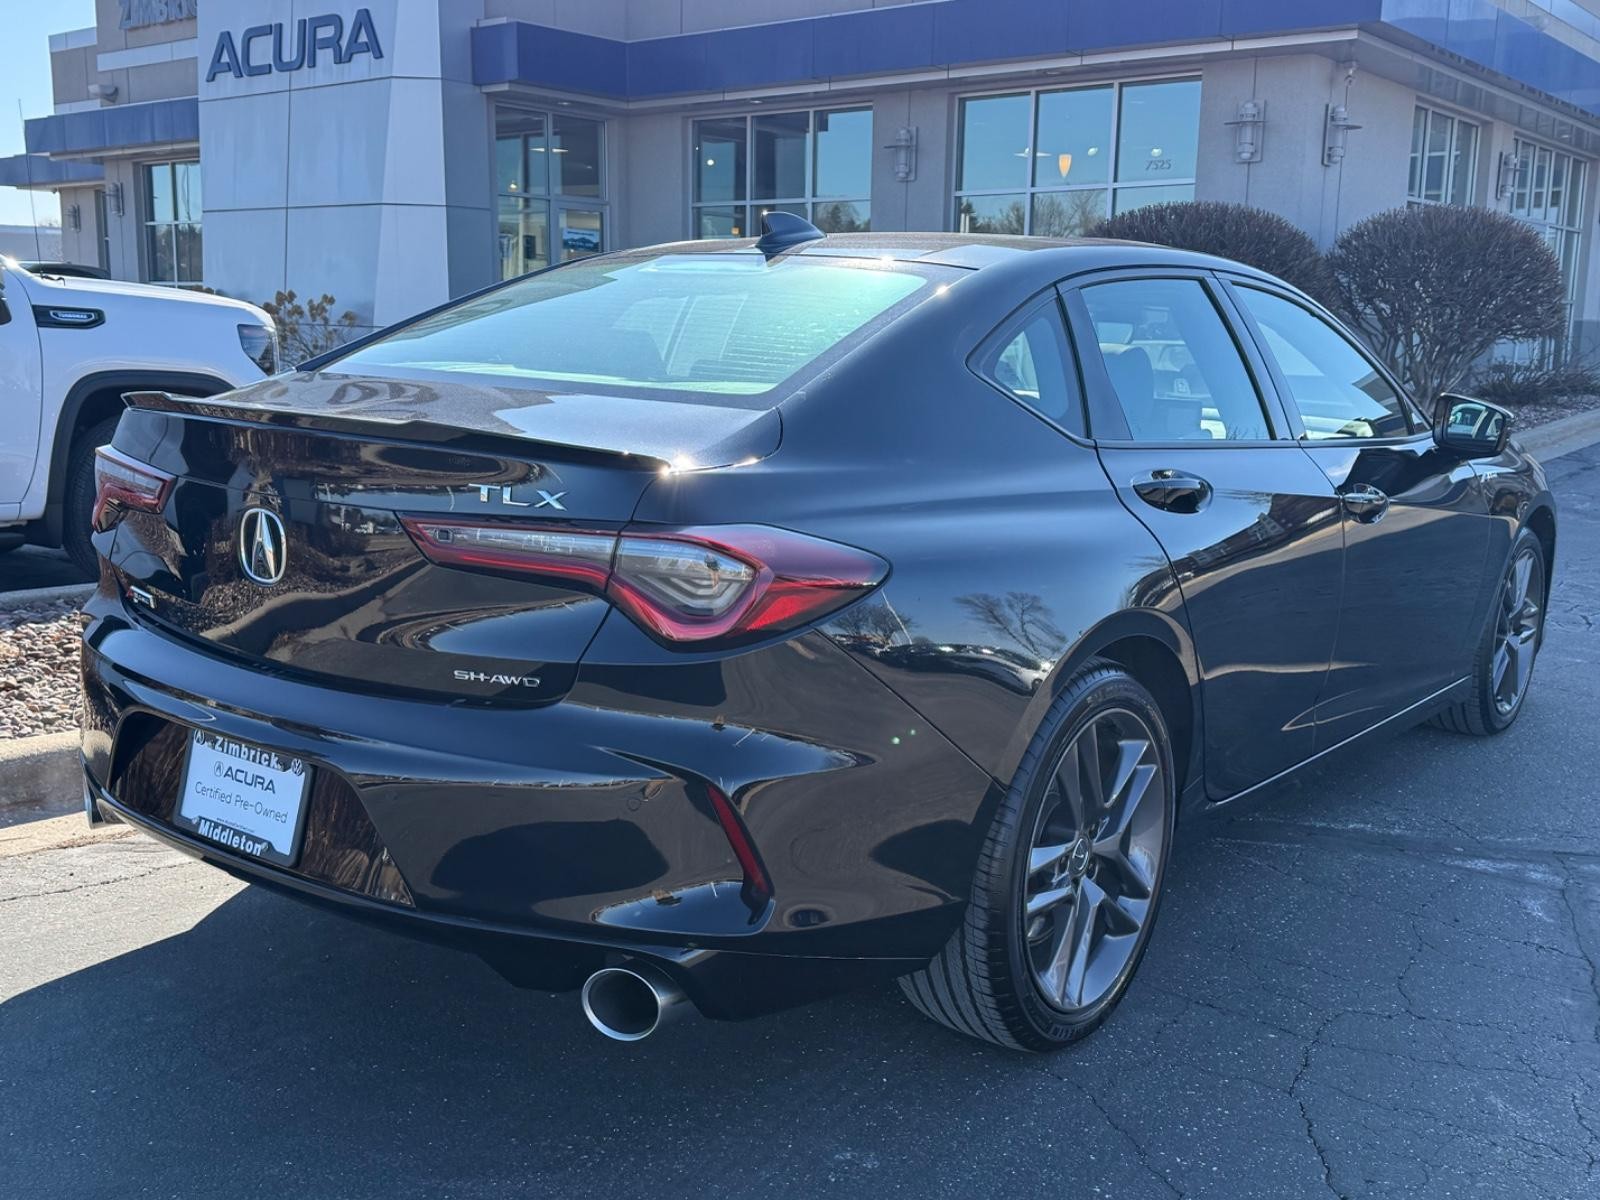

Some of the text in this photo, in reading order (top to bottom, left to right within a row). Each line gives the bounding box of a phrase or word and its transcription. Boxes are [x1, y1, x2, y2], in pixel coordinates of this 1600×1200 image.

[205, 8, 384, 82] ACURA
[1145, 159, 1171, 170] 7525
[468, 483, 568, 511] TLX
[453, 670, 540, 688] SH-AWD
[214, 735, 280, 770] Zimbrick
[223, 766, 276, 794] ACURA
[195, 781, 288, 824] Certified Pre-Owned
[198, 818, 262, 857] Middleton
